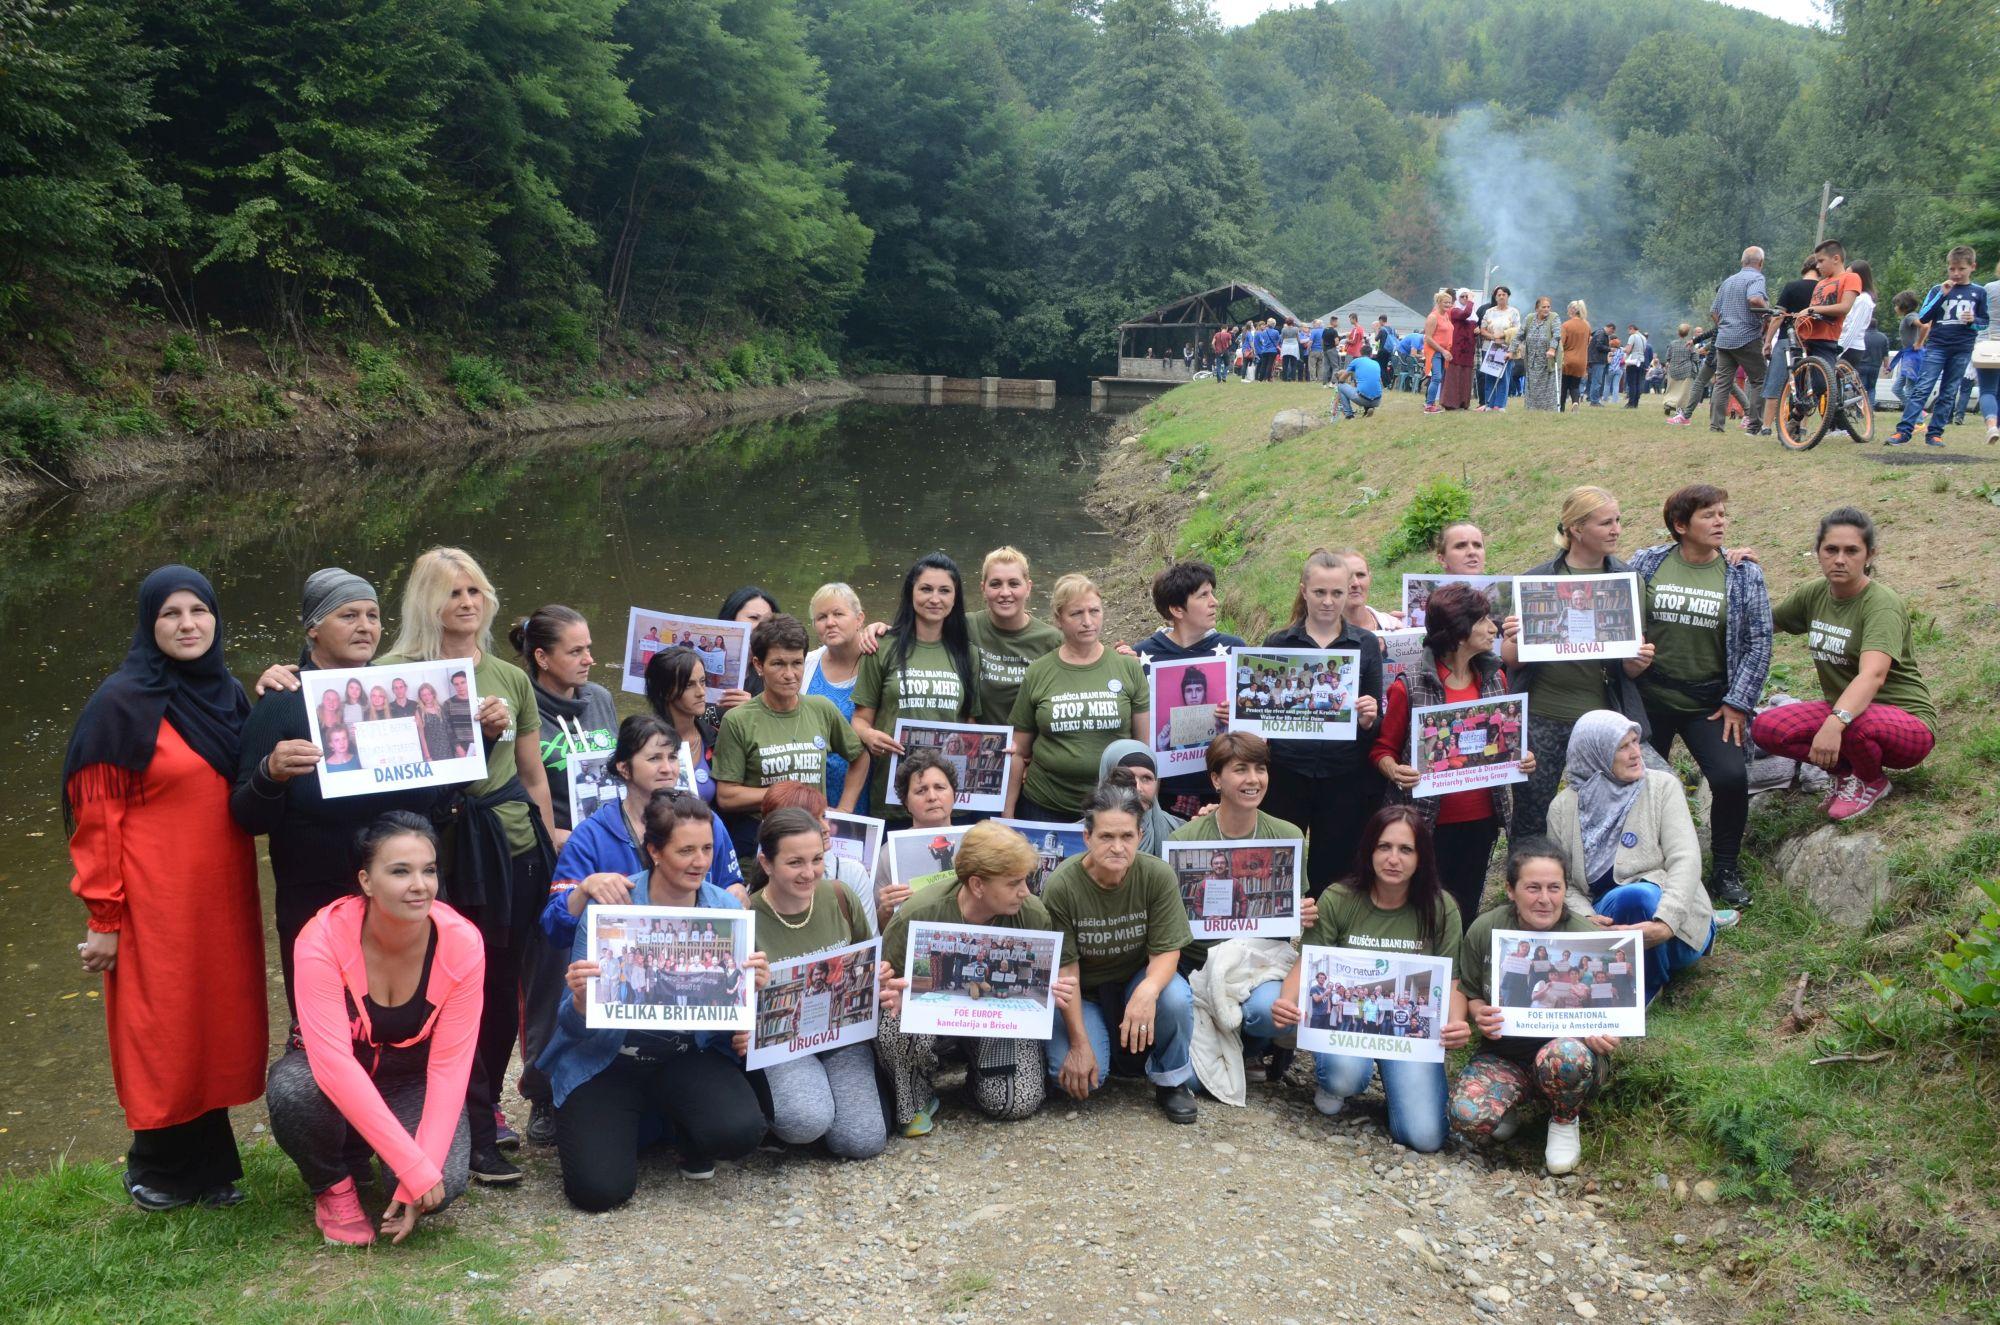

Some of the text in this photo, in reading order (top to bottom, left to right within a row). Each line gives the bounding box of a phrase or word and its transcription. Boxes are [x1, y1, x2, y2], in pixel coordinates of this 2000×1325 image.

[1654, 593, 1720, 617] STOP MHE!
[1680, 613, 1692, 625] NE
[1692, 615, 1720, 630] DAMO!
[1555, 642, 1604, 654] URUGVAJ
[900, 680, 960, 697] STOP MHE!
[927, 698, 937, 708] NE
[1052, 700, 1118, 719] STOP MHE!
[1050, 718, 1121, 732] RIJEKU NE DAMO!
[1262, 721, 1324, 732] MOZAMBIK
[762, 753, 822, 775] STOP MHE!
[374, 762, 433, 782] DANSKA
[1432, 772, 1508, 788] Patriarchy Working Group
[1204, 919, 1258, 931] URUGVAJ
[1078, 924, 1147, 944] STOP MHE!
[1348, 934, 1379, 947] KRUŠČICA
[1380, 938, 1402, 948] BRANI
[1109, 946, 1120, 954] ne
[605, 1005, 738, 1021] VELIKA BRITANIJA
[954, 1009, 1003, 1018] FOE EUROPE
[1528, 1011, 1607, 1019] FOE INTERNATIONAL
[937, 1018, 980, 1029] kancelarija
[990, 1021, 1018, 1030] Briselu
[1516, 1022, 1559, 1031] kancelarija
[789, 1028, 839, 1052] URUGVAJ
[1329, 1031, 1412, 1053] ŠVAJCARSKA
